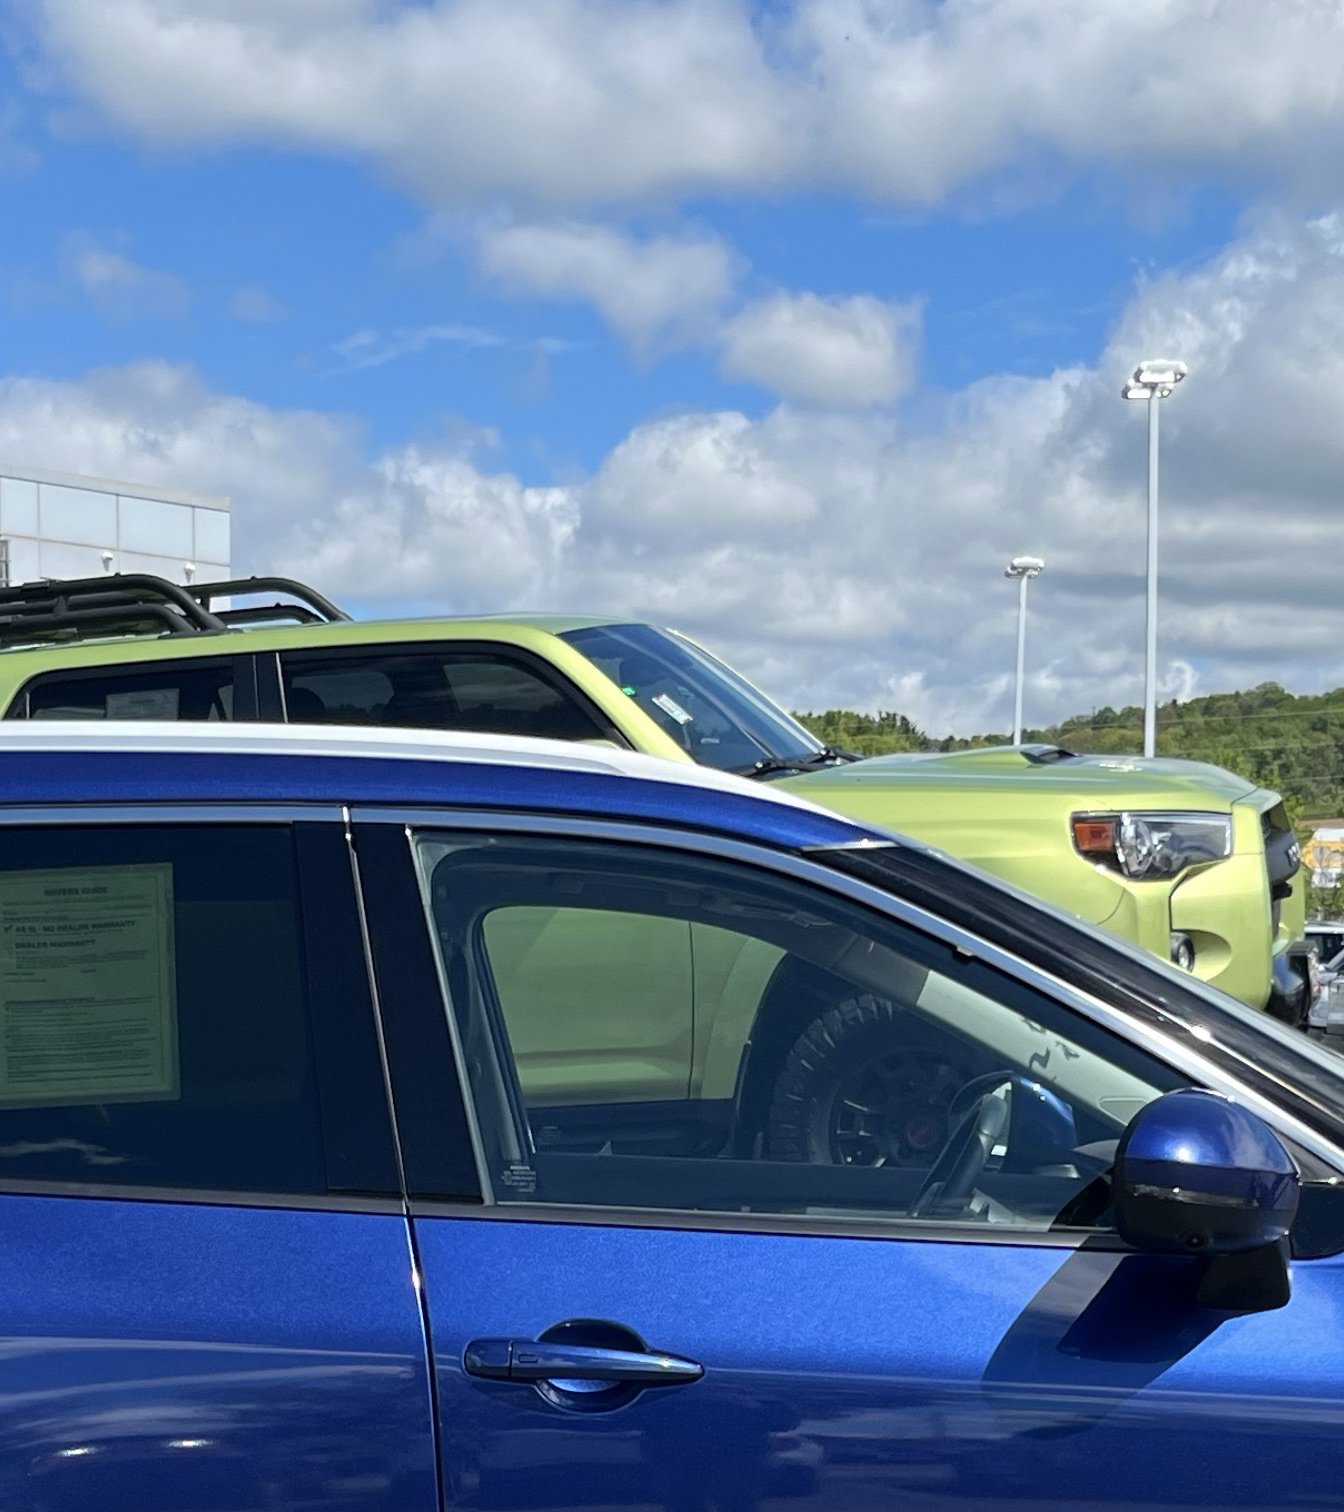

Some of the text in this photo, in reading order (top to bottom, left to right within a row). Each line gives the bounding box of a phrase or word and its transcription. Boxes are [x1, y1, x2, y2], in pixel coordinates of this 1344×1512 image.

[56, 922, 90, 933] DEALER
[90, 919, 137, 931] WARRANTY
[14, 938, 97, 950] DEALER WARRANTY
